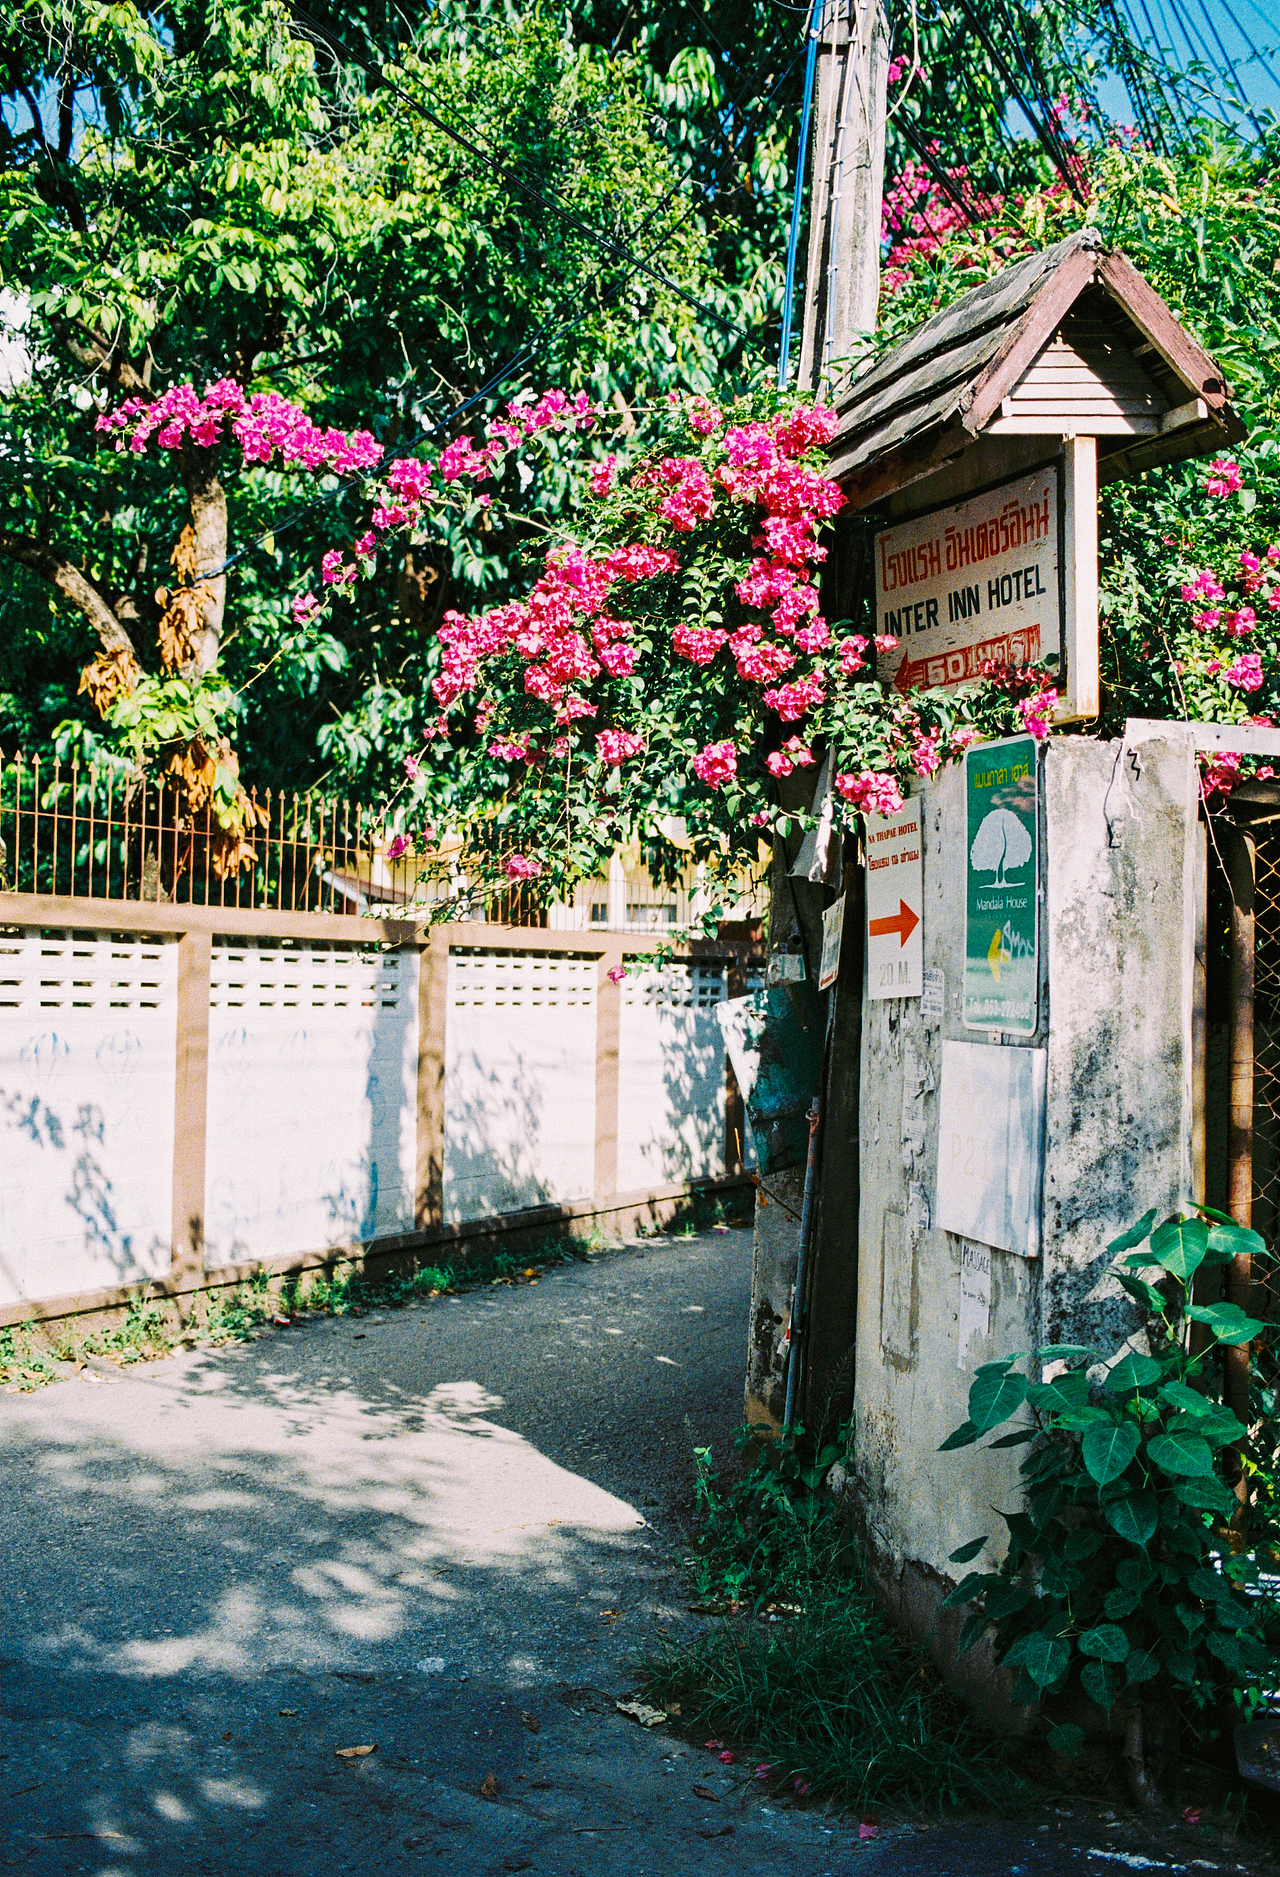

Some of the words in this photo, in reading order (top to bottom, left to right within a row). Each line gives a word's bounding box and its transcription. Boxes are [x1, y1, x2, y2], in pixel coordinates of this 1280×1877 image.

[878, 534, 942, 592] โรงแรม
[884, 598, 939, 638] INTER
[947, 584, 980, 622] INN
[987, 564, 1046, 610] HOTEL
[868, 834, 875, 844] NA
[876, 827, 897, 842] THAPAE
[898, 821, 918, 836] HOTEL
[868, 854, 890, 871] โรงแรม
[976, 895, 1004, 912] Mandala
[1006, 894, 1028, 909] House
[879, 962, 894, 987] 20
